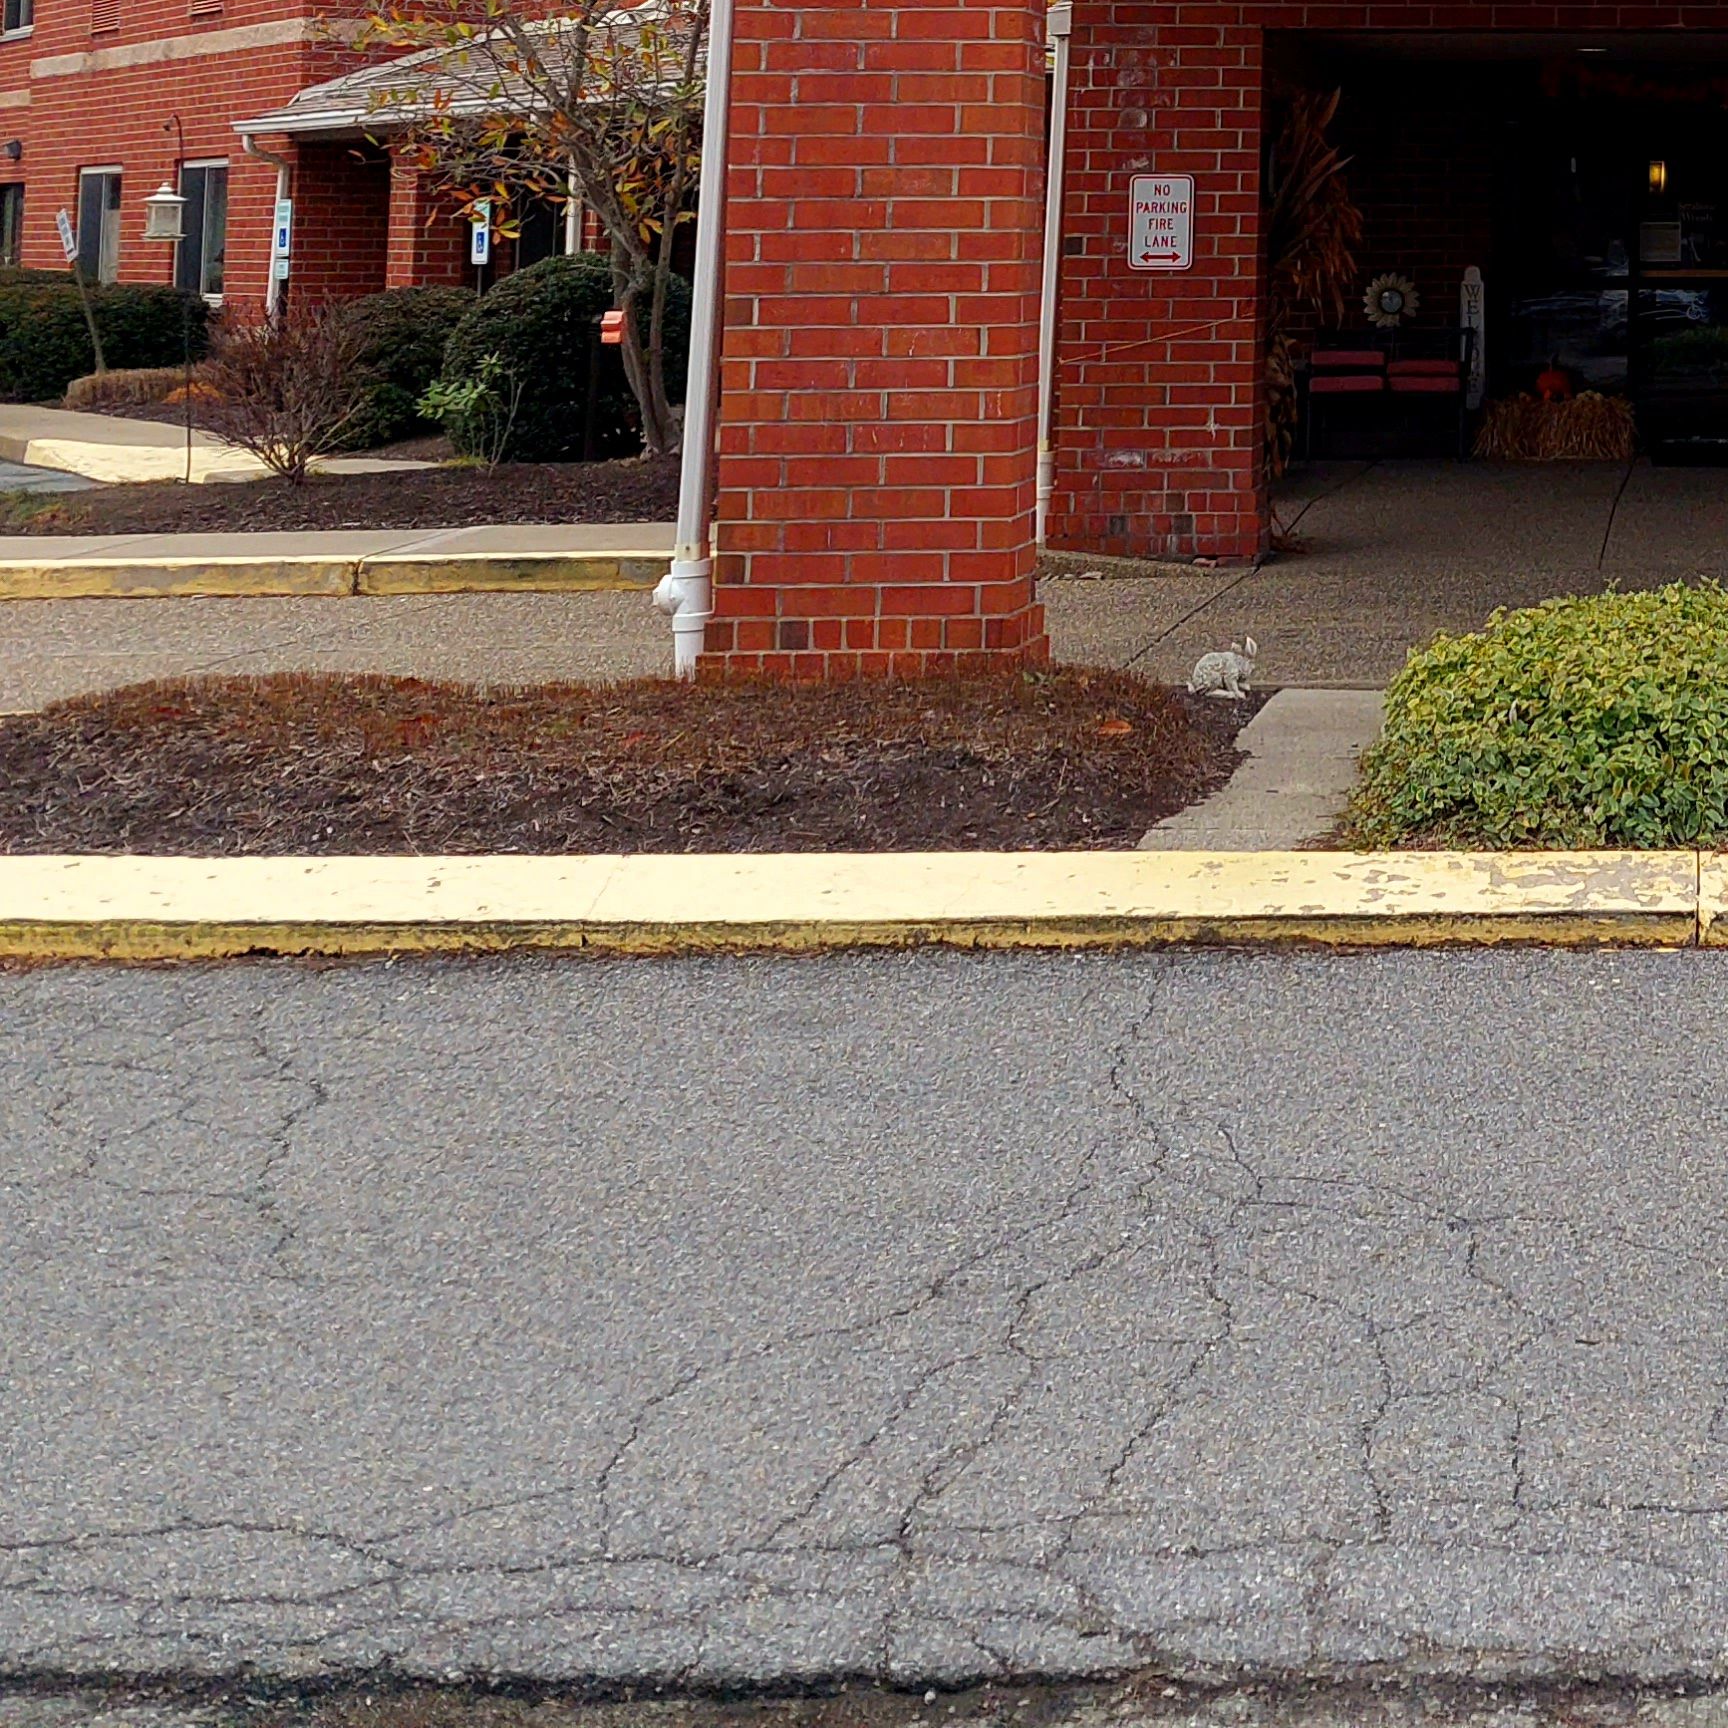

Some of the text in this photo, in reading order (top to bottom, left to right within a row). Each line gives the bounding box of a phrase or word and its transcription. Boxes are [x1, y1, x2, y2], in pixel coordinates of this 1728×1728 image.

[1154, 184, 1170, 196] NO
[1136, 201, 1187, 214] PARKING
[1148, 218, 1173, 230] FIRE
[1145, 236, 1177, 248] LANE
